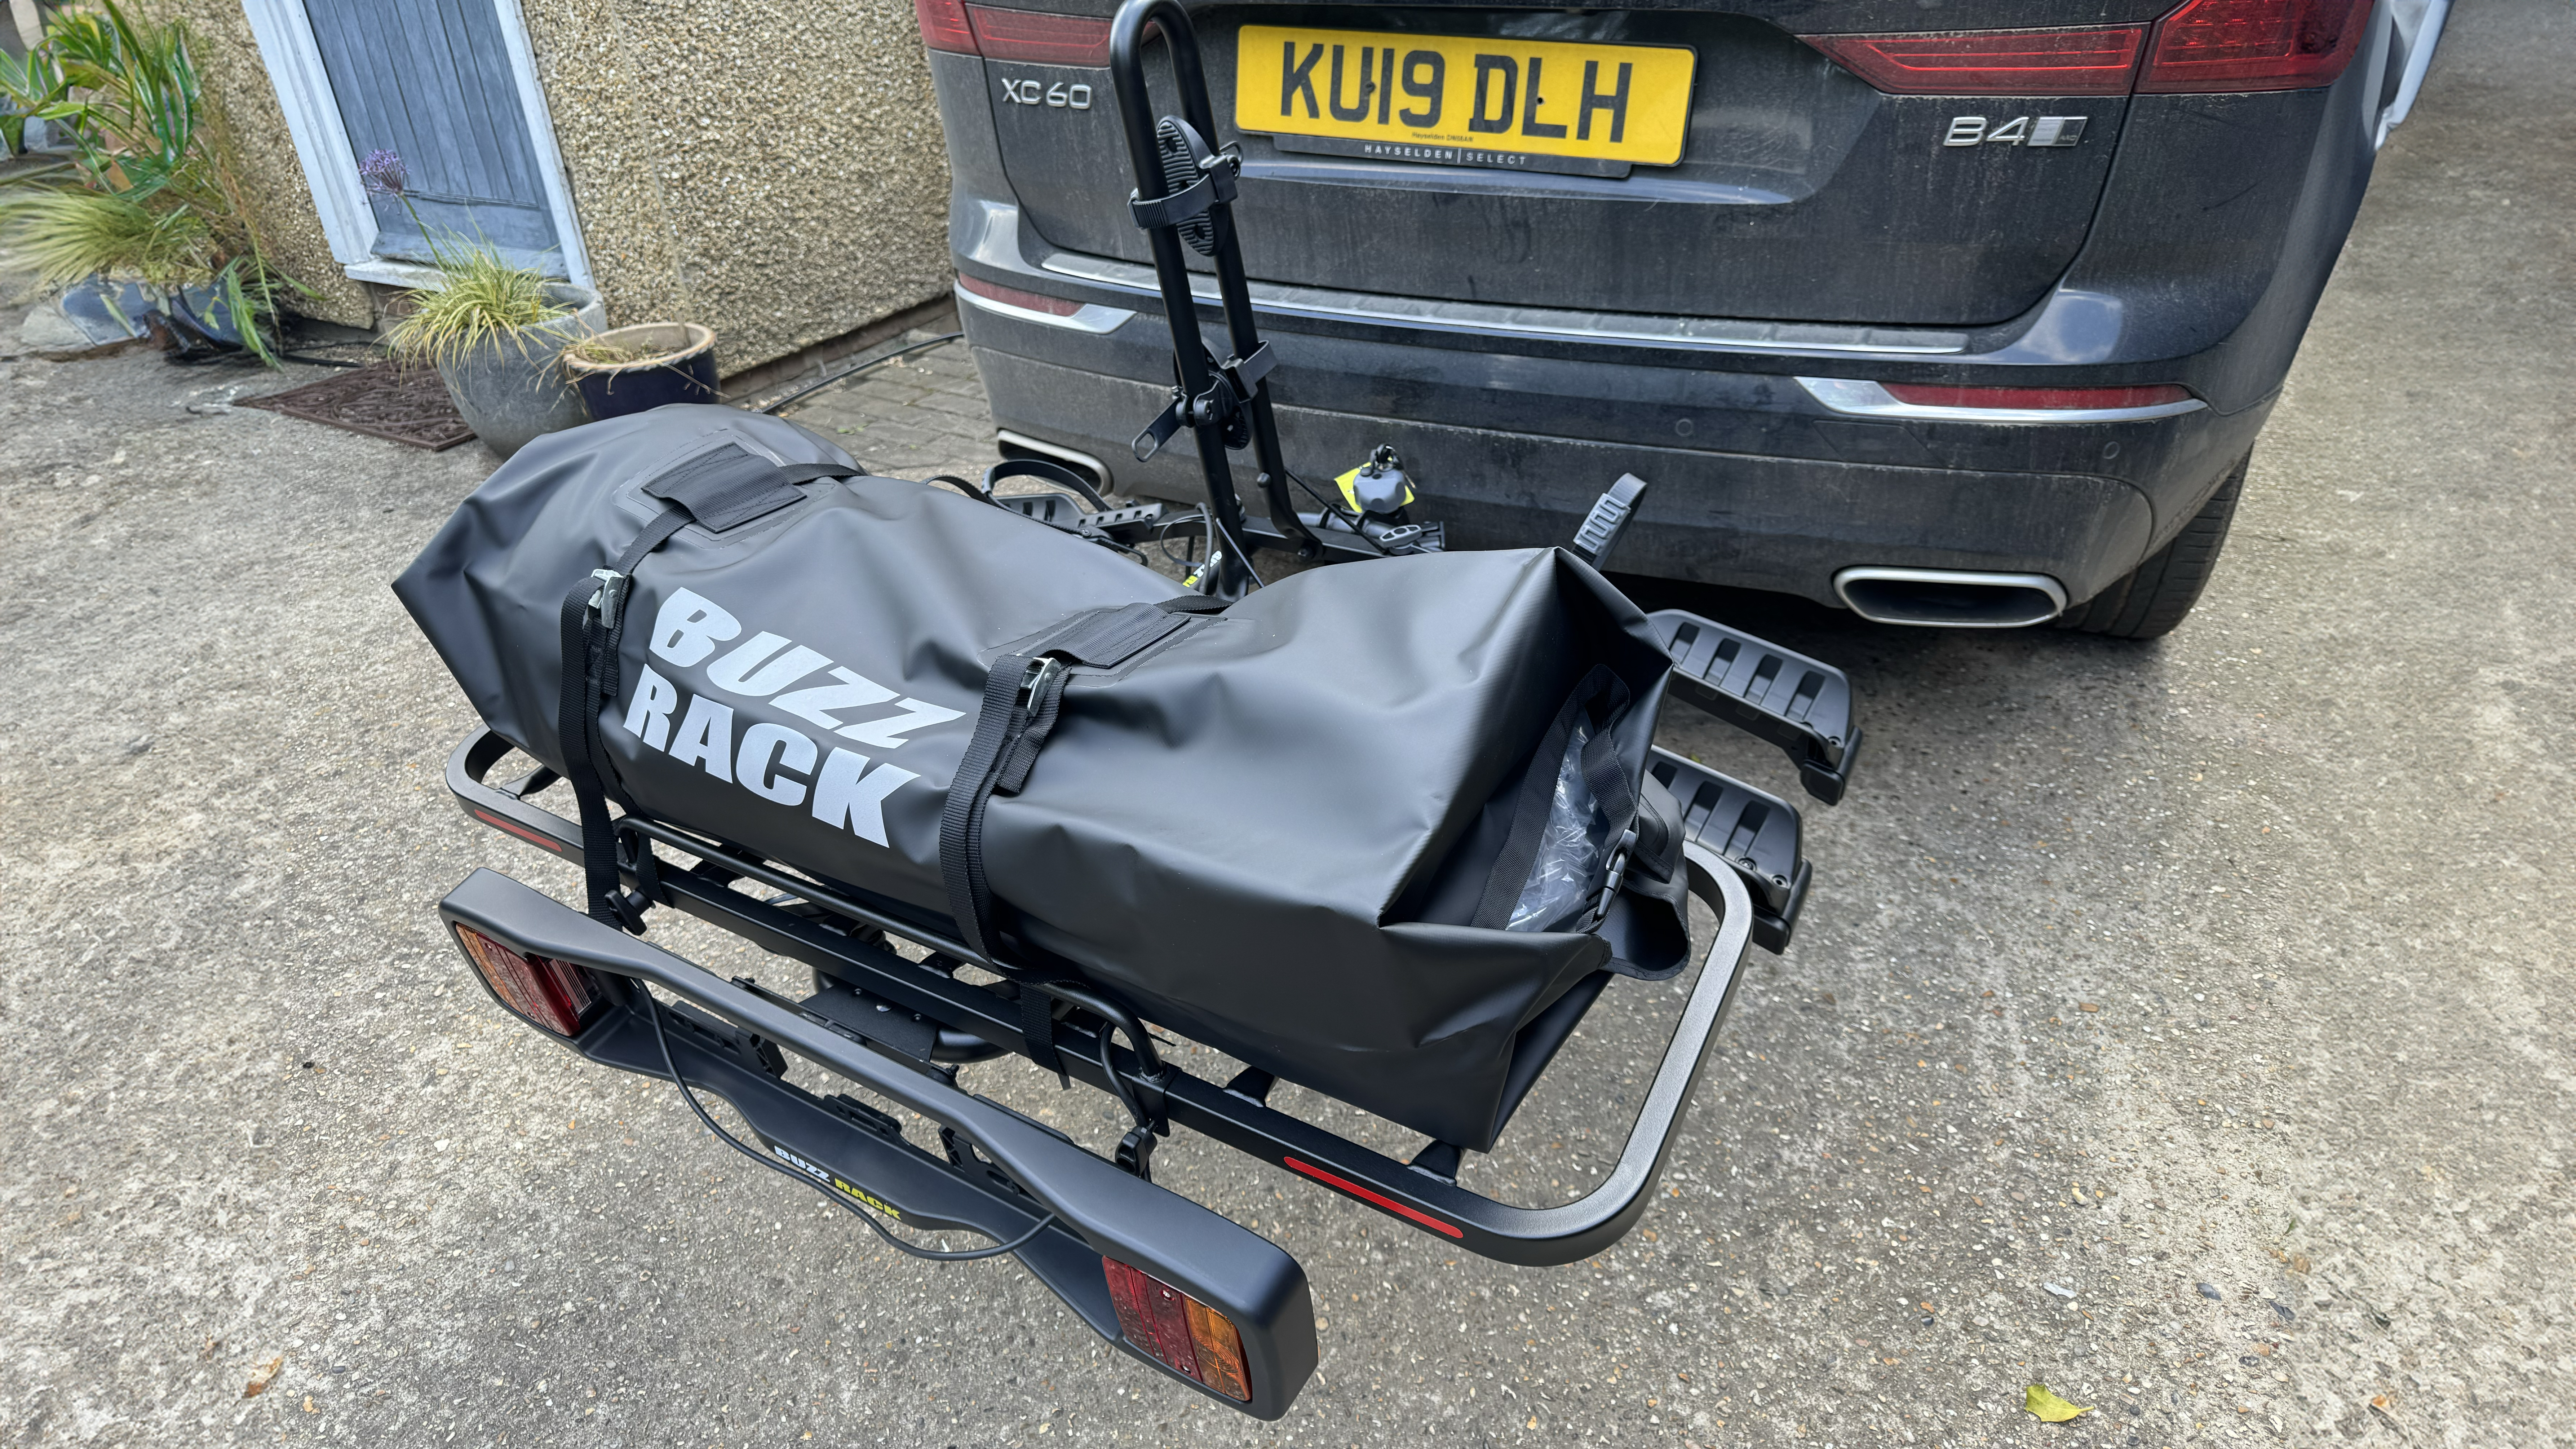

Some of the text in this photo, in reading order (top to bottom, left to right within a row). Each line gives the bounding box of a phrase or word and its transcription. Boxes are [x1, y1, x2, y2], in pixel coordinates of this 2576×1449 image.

[1280, 40, 1633, 143] KU19 DLH
[1943, 116, 2030, 146] B4
[1364, 144, 1527, 165] HAYSELDEN SELECT
[649, 587, 966, 749] BUZZ
[623, 663, 921, 848] RACK
[774, 1145, 902, 1221] BUZZ RACK
